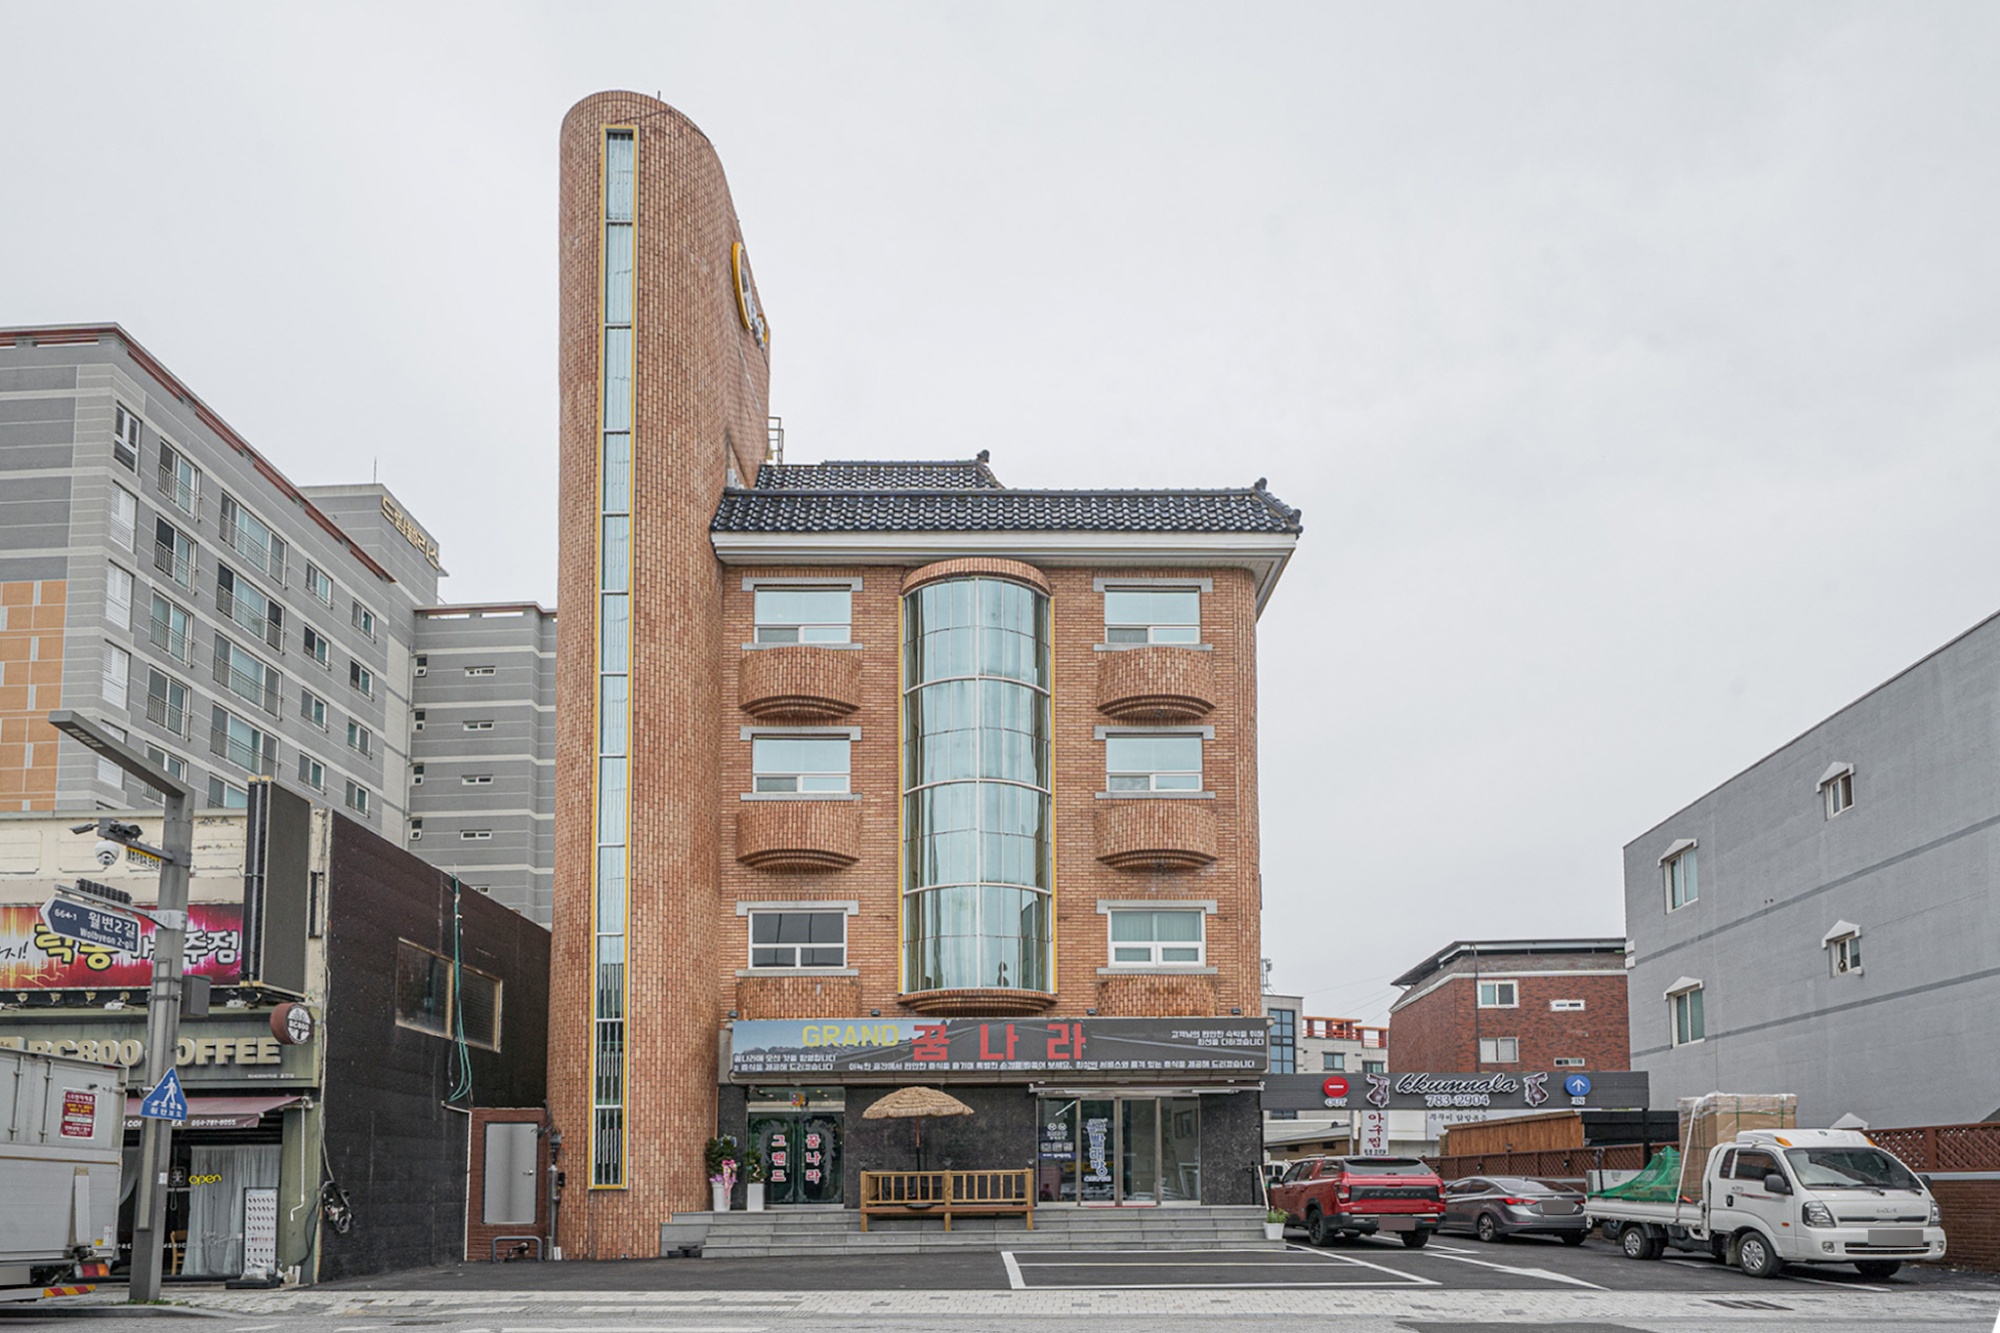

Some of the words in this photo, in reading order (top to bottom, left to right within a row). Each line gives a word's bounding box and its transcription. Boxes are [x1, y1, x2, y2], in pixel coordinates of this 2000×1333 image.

[88, 911, 136, 939] 월변2길
[80, 927, 117, 946] Wolbyeon
[117, 937, 135, 950] 2-gil
[288, 1019, 310, 1032] BC800
[802, 1024, 899, 1047] GRAND
[1201, 1030, 1224, 1038] 편안한
[1249, 1030, 1265, 1038] 위해
[1221, 1038, 1264, 1046] 다하겠습니다
[145, 1037, 281, 1067] OFFEE
[733, 1054, 764, 1063] 꿈나라에
[765, 1054, 781, 1063] 오신
[782, 1054, 797, 1062] 것을
[799, 1053, 836, 1063] 환영합니다
[789, 1063, 834, 1071] 드리겠습니다
[1211, 1060, 1255, 1069] 드리겠습니다
[1395, 1072, 1519, 1094] kkumnala
[1425, 1093, 1490, 1108] 783-2904
[771, 1134, 788, 1182] 그랜드
[805, 1133, 822, 1185] 꿈나라
[188, 1173, 223, 1186] open
